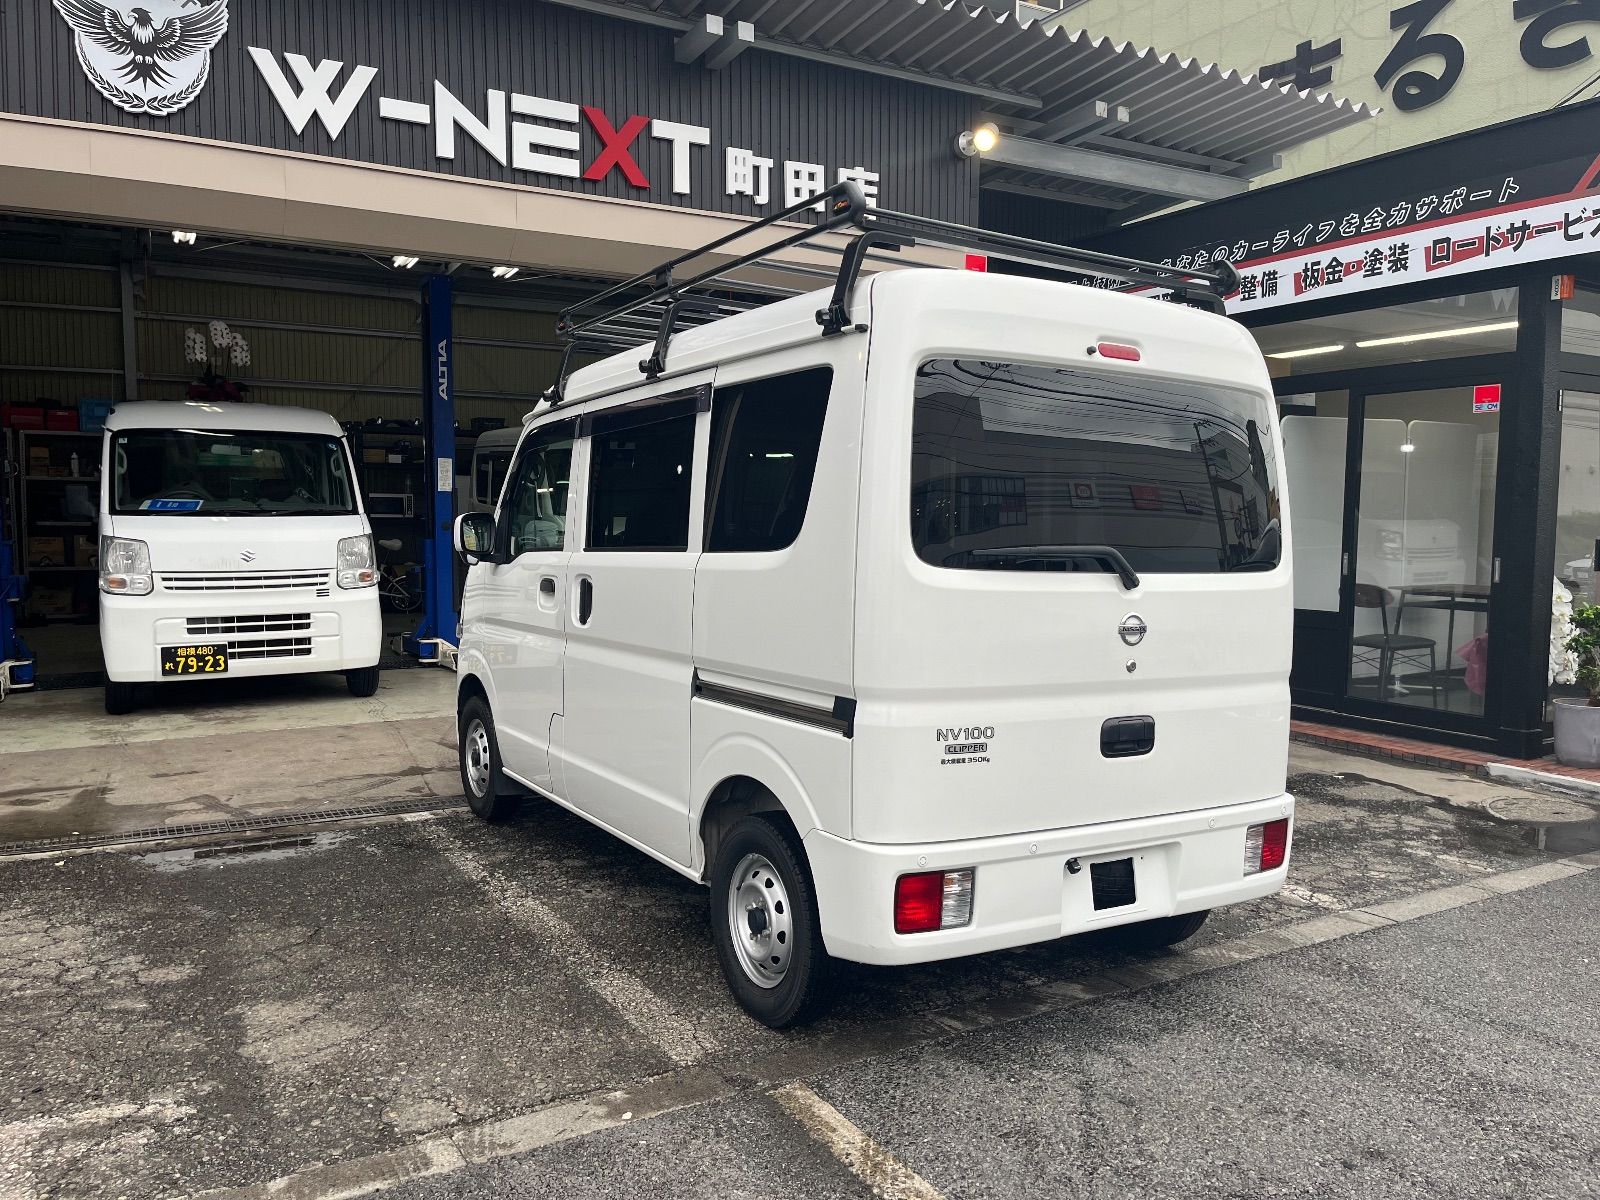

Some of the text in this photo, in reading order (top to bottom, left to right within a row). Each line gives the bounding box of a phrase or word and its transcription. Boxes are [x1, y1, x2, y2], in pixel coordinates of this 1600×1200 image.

[247, 46, 710, 195] W-NEXT
[1302, 242, 1410, 291] 板金・塗装
[177, 646, 213, 656] 相模 480
[165, 655, 225, 673] れ 79-23
[936, 726, 995, 741] NV100
[947, 744, 985, 752] CLIPPER
